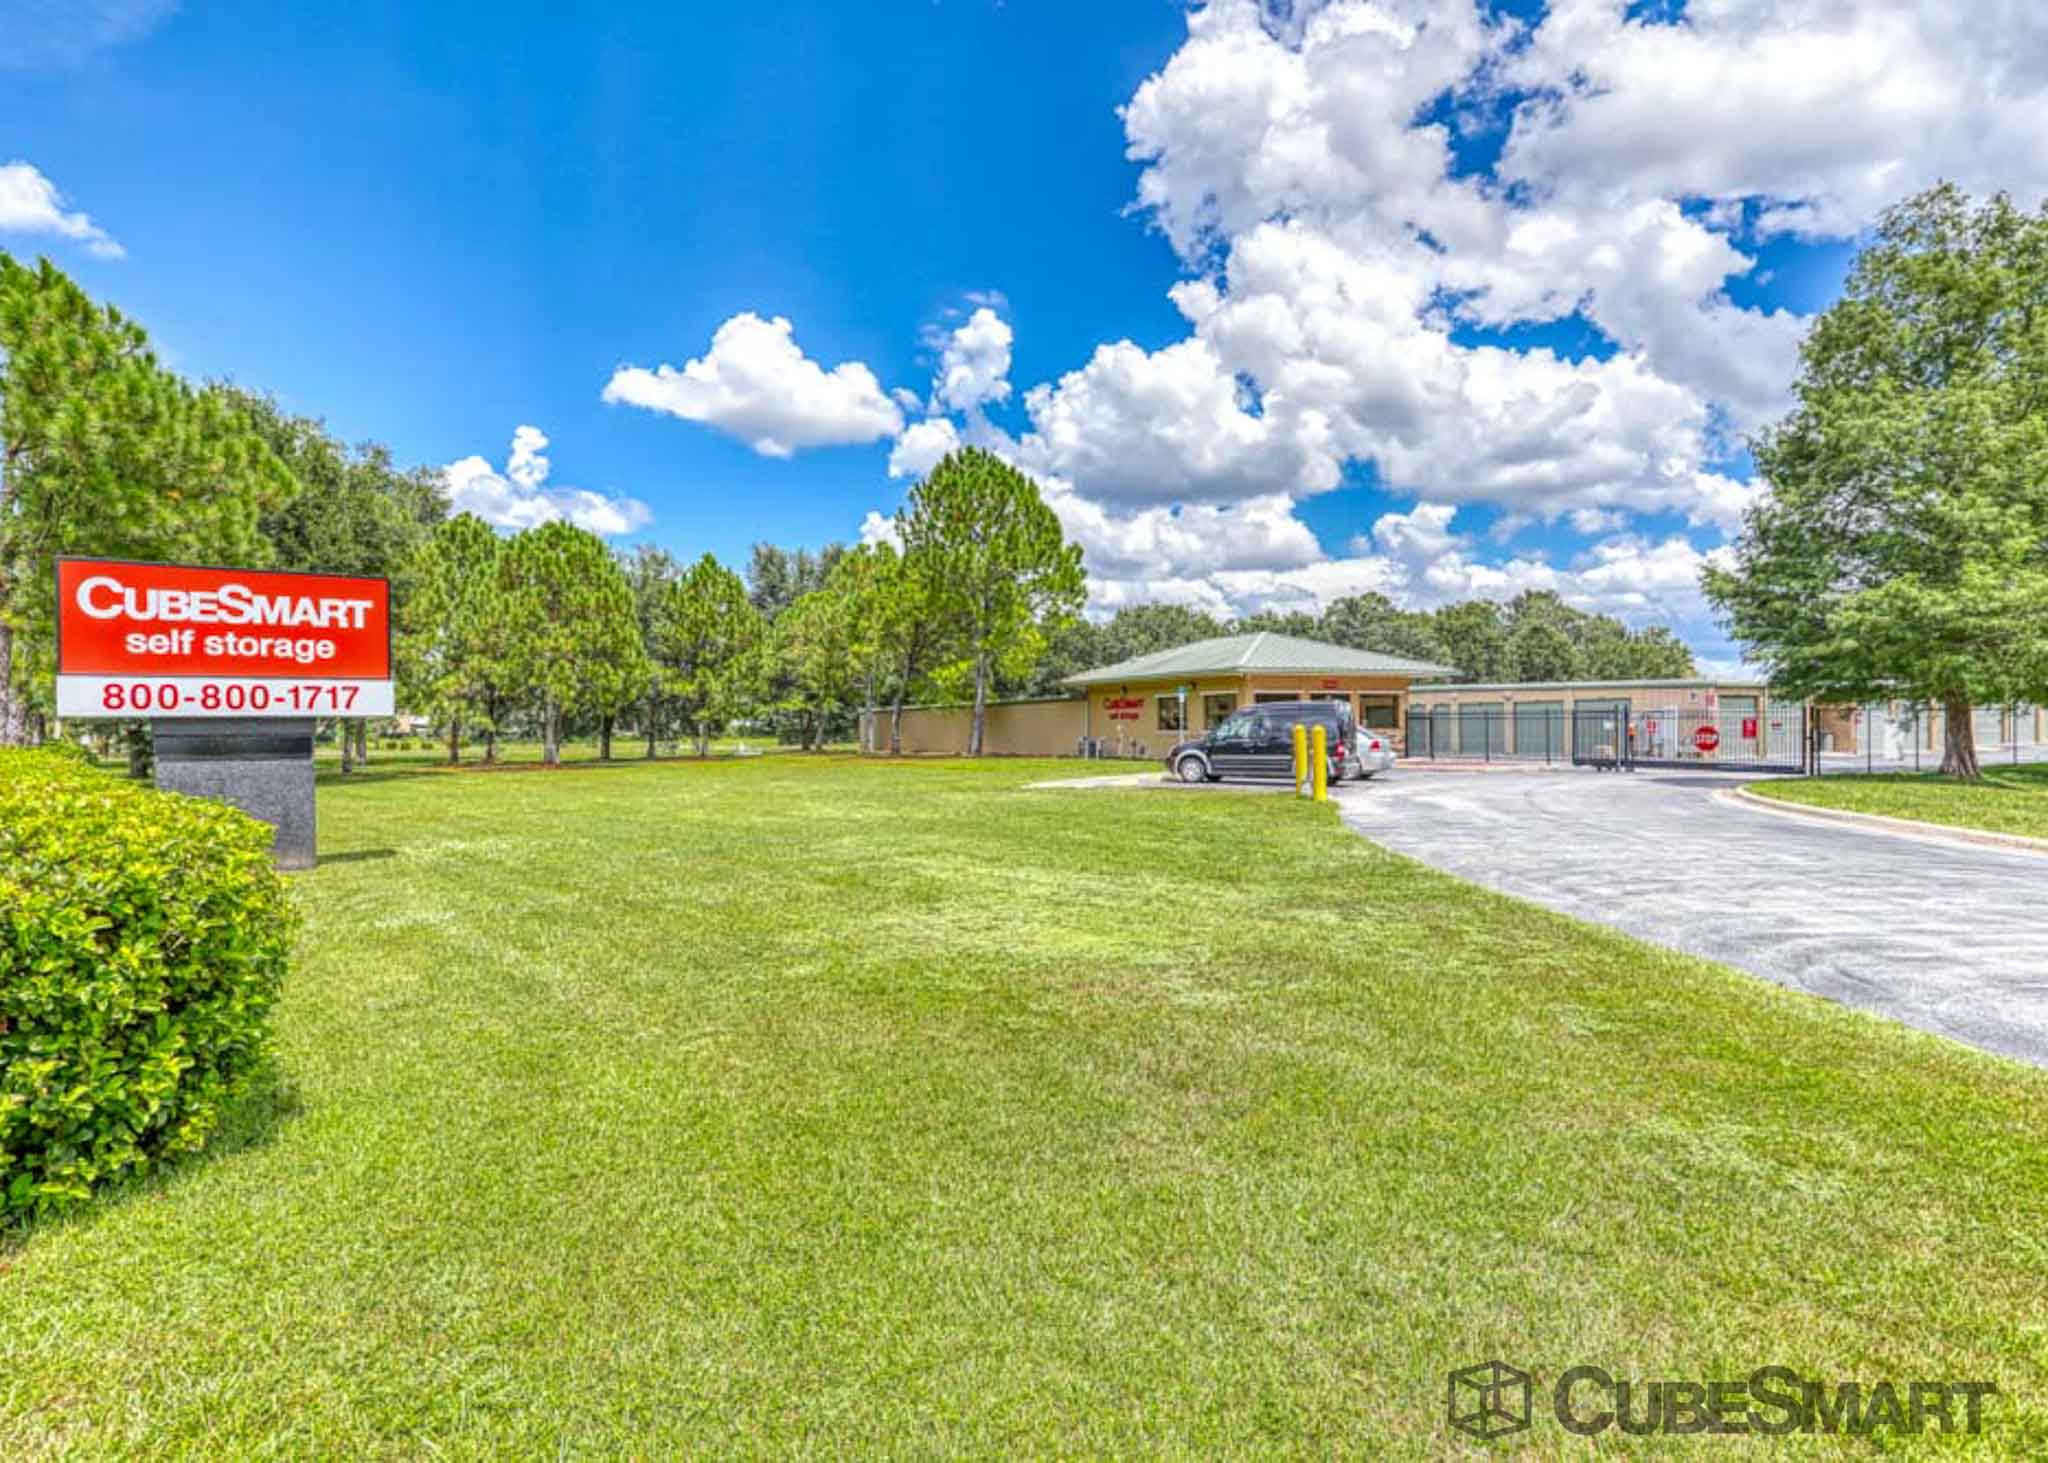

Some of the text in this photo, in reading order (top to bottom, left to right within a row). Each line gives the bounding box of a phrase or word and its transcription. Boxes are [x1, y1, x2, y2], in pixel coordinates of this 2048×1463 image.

[125, 629, 336, 663] self storage
[102, 684, 360, 710] 800-800-1717
